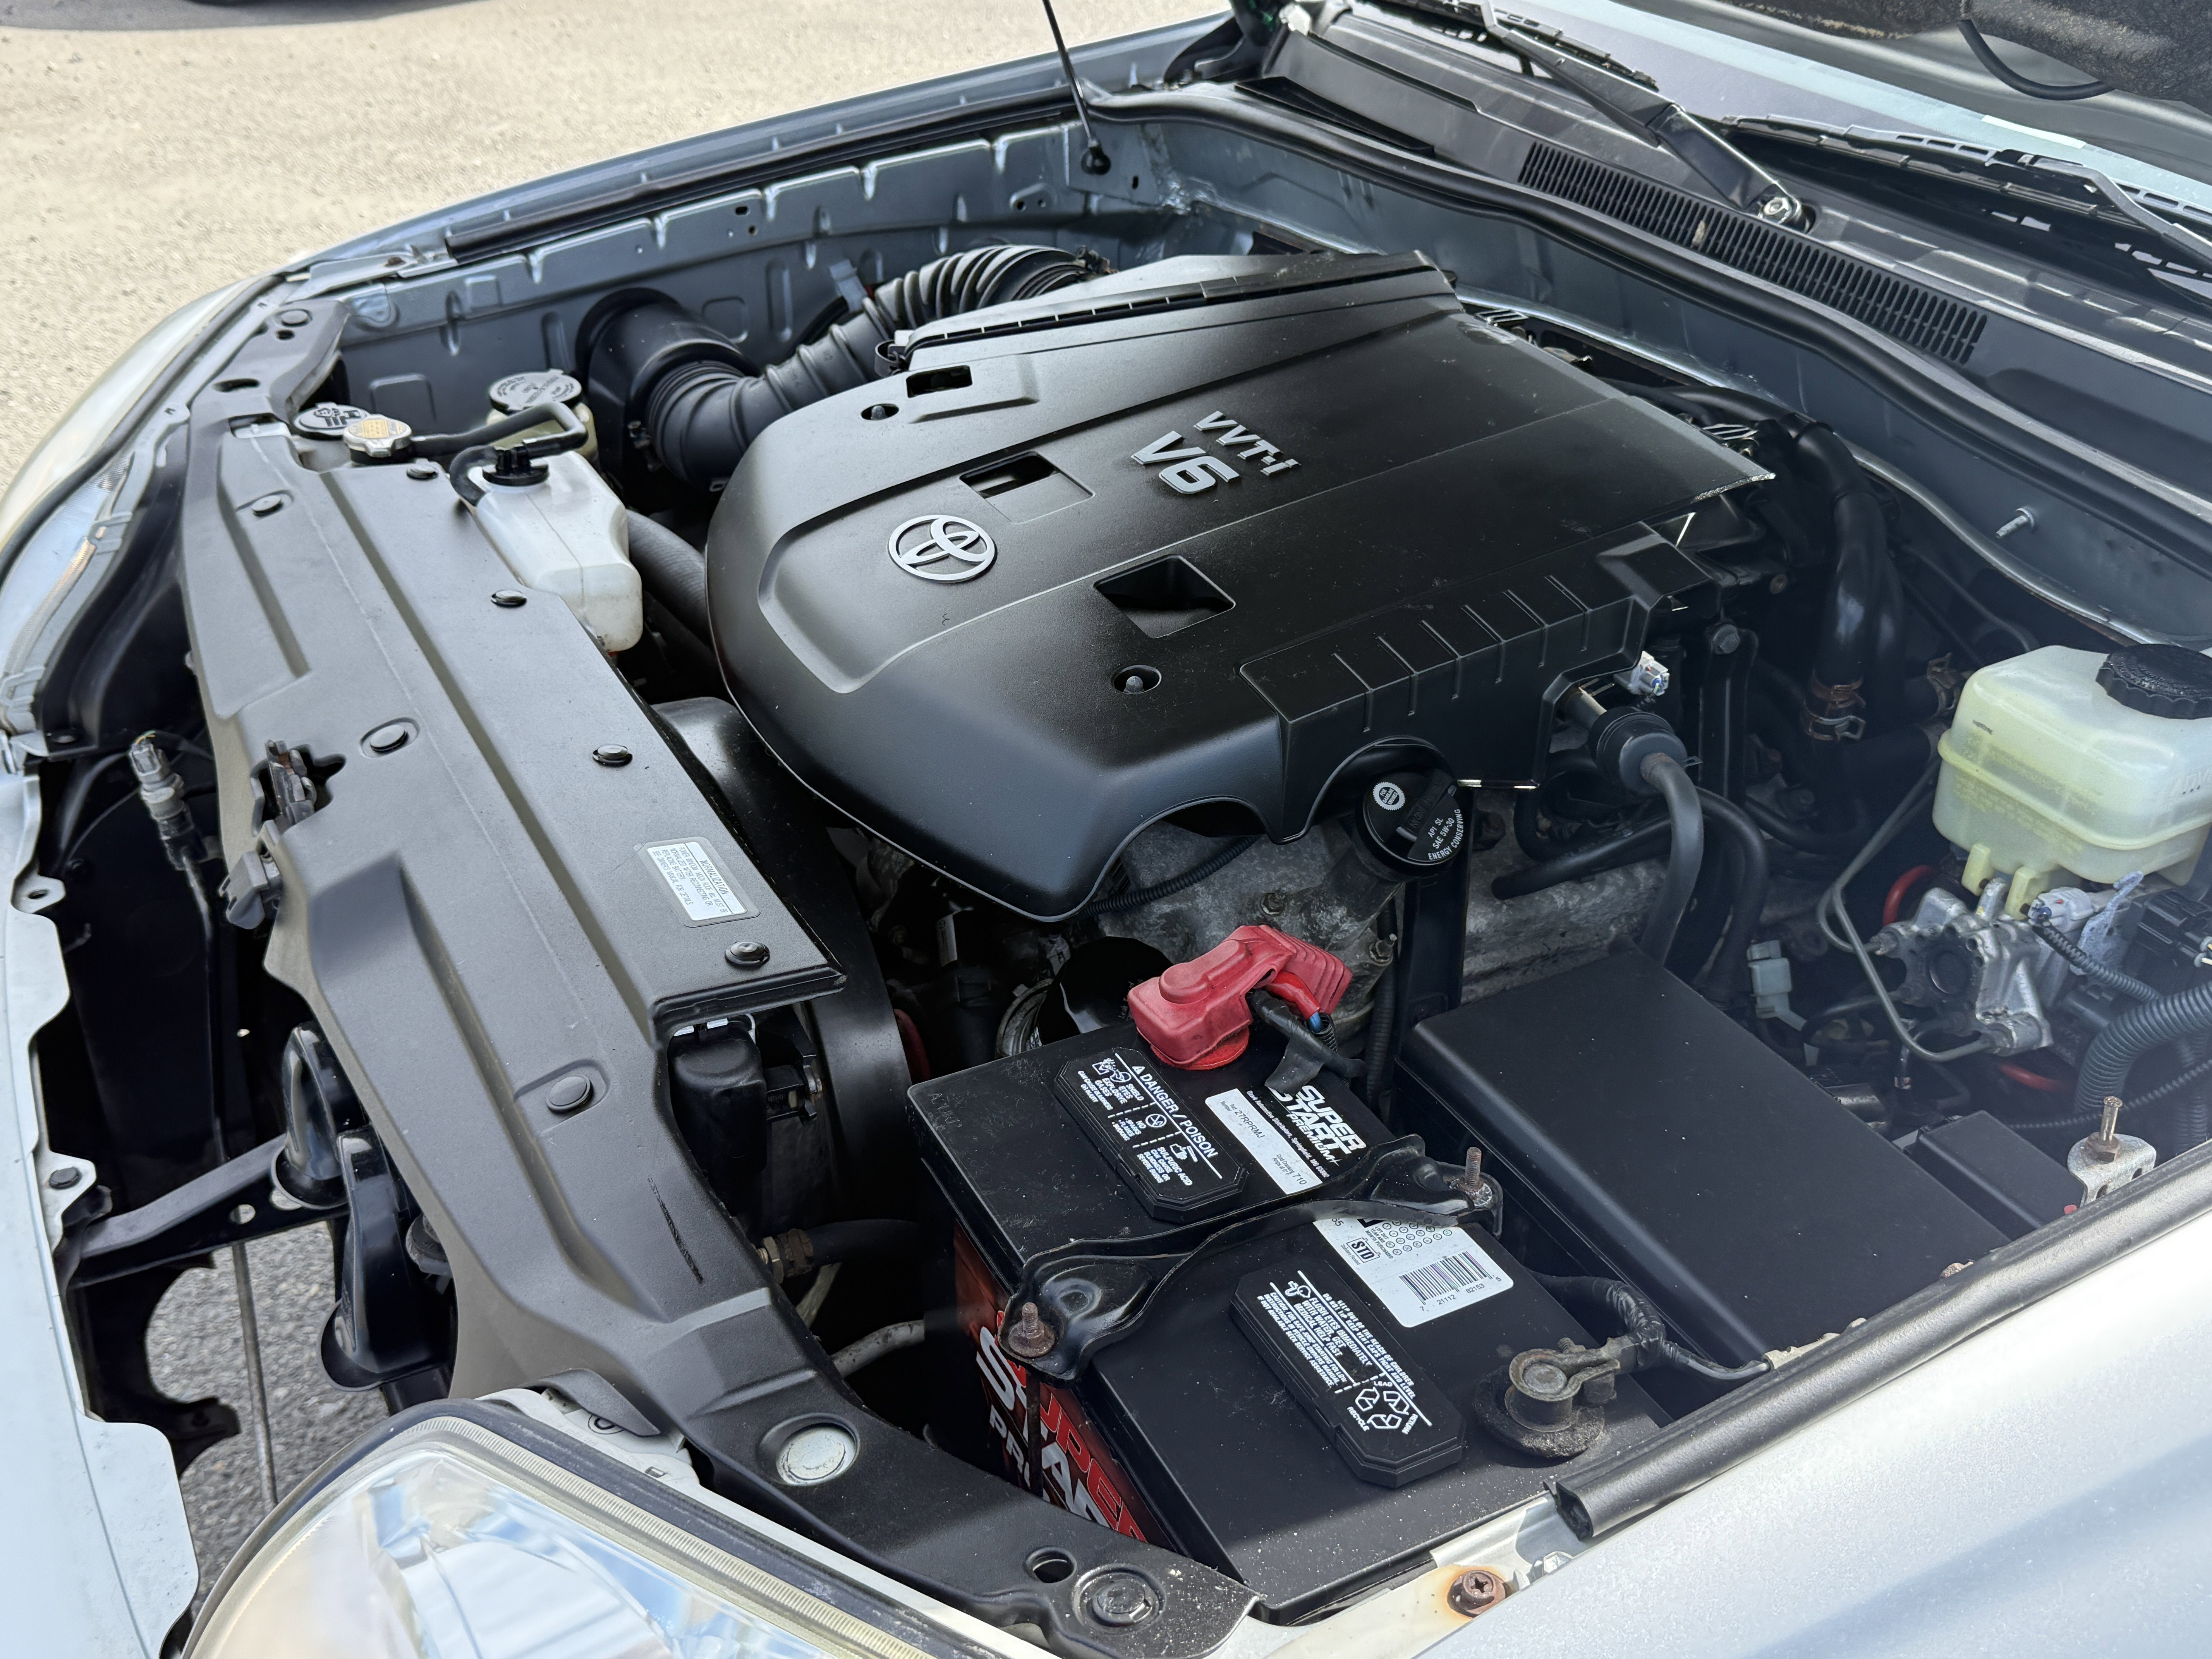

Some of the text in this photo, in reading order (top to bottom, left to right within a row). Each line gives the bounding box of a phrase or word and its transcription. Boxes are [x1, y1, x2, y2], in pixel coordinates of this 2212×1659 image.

[1194, 410, 1301, 476] VVT-i
[1131, 431, 1240, 494] V6
[1428, 818, 1443, 838] API SL
[1428, 809, 1464, 860] ENERGY CONSERVING
[1432, 818, 1454, 849] SAE 5W-30
[700, 860, 730, 895] NORMALIZATION
[1102, 1078, 1128, 1104] EXPLOSIVE
[1126, 1084, 1144, 1101] SHIELD
[1135, 1120, 1147, 1128] NO
[1140, 1073, 1179, 1113] DANGER
[1180, 1120, 1218, 1158] POISON
[1234, 1110, 1266, 1138] 27RPRMJ
[1255, 1100, 1274, 1118] Automotive
[1297, 1085, 1366, 1150] SUPER
[1157, 1147, 1193, 1186] SULFURIC ACID
[1293, 1173, 1307, 1185] 710
[1351, 1241, 1375, 1261] STD
[1437, 1295, 1456, 1305] 21112
[1293, 1303, 1343, 1356] MEDICAL HELP FAST
[1302, 1300, 1319, 1316] WITH
[1332, 1336, 1346, 1348] GET
[1309, 1297, 1372, 1365] FLUSH EYES IMMEDIATELY
[1367, 1344, 1381, 1358] CAPS
[1378, 1356, 1394, 1372] TIGHT
[1391, 1372, 1403, 1382] AND
[1370, 1338, 1387, 1355] REACH
[1390, 1362, 1414, 1387] CHILDREN
[1347, 1407, 1370, 1431] RECYCLE
[1402, 1413, 1419, 1435] RETURN
